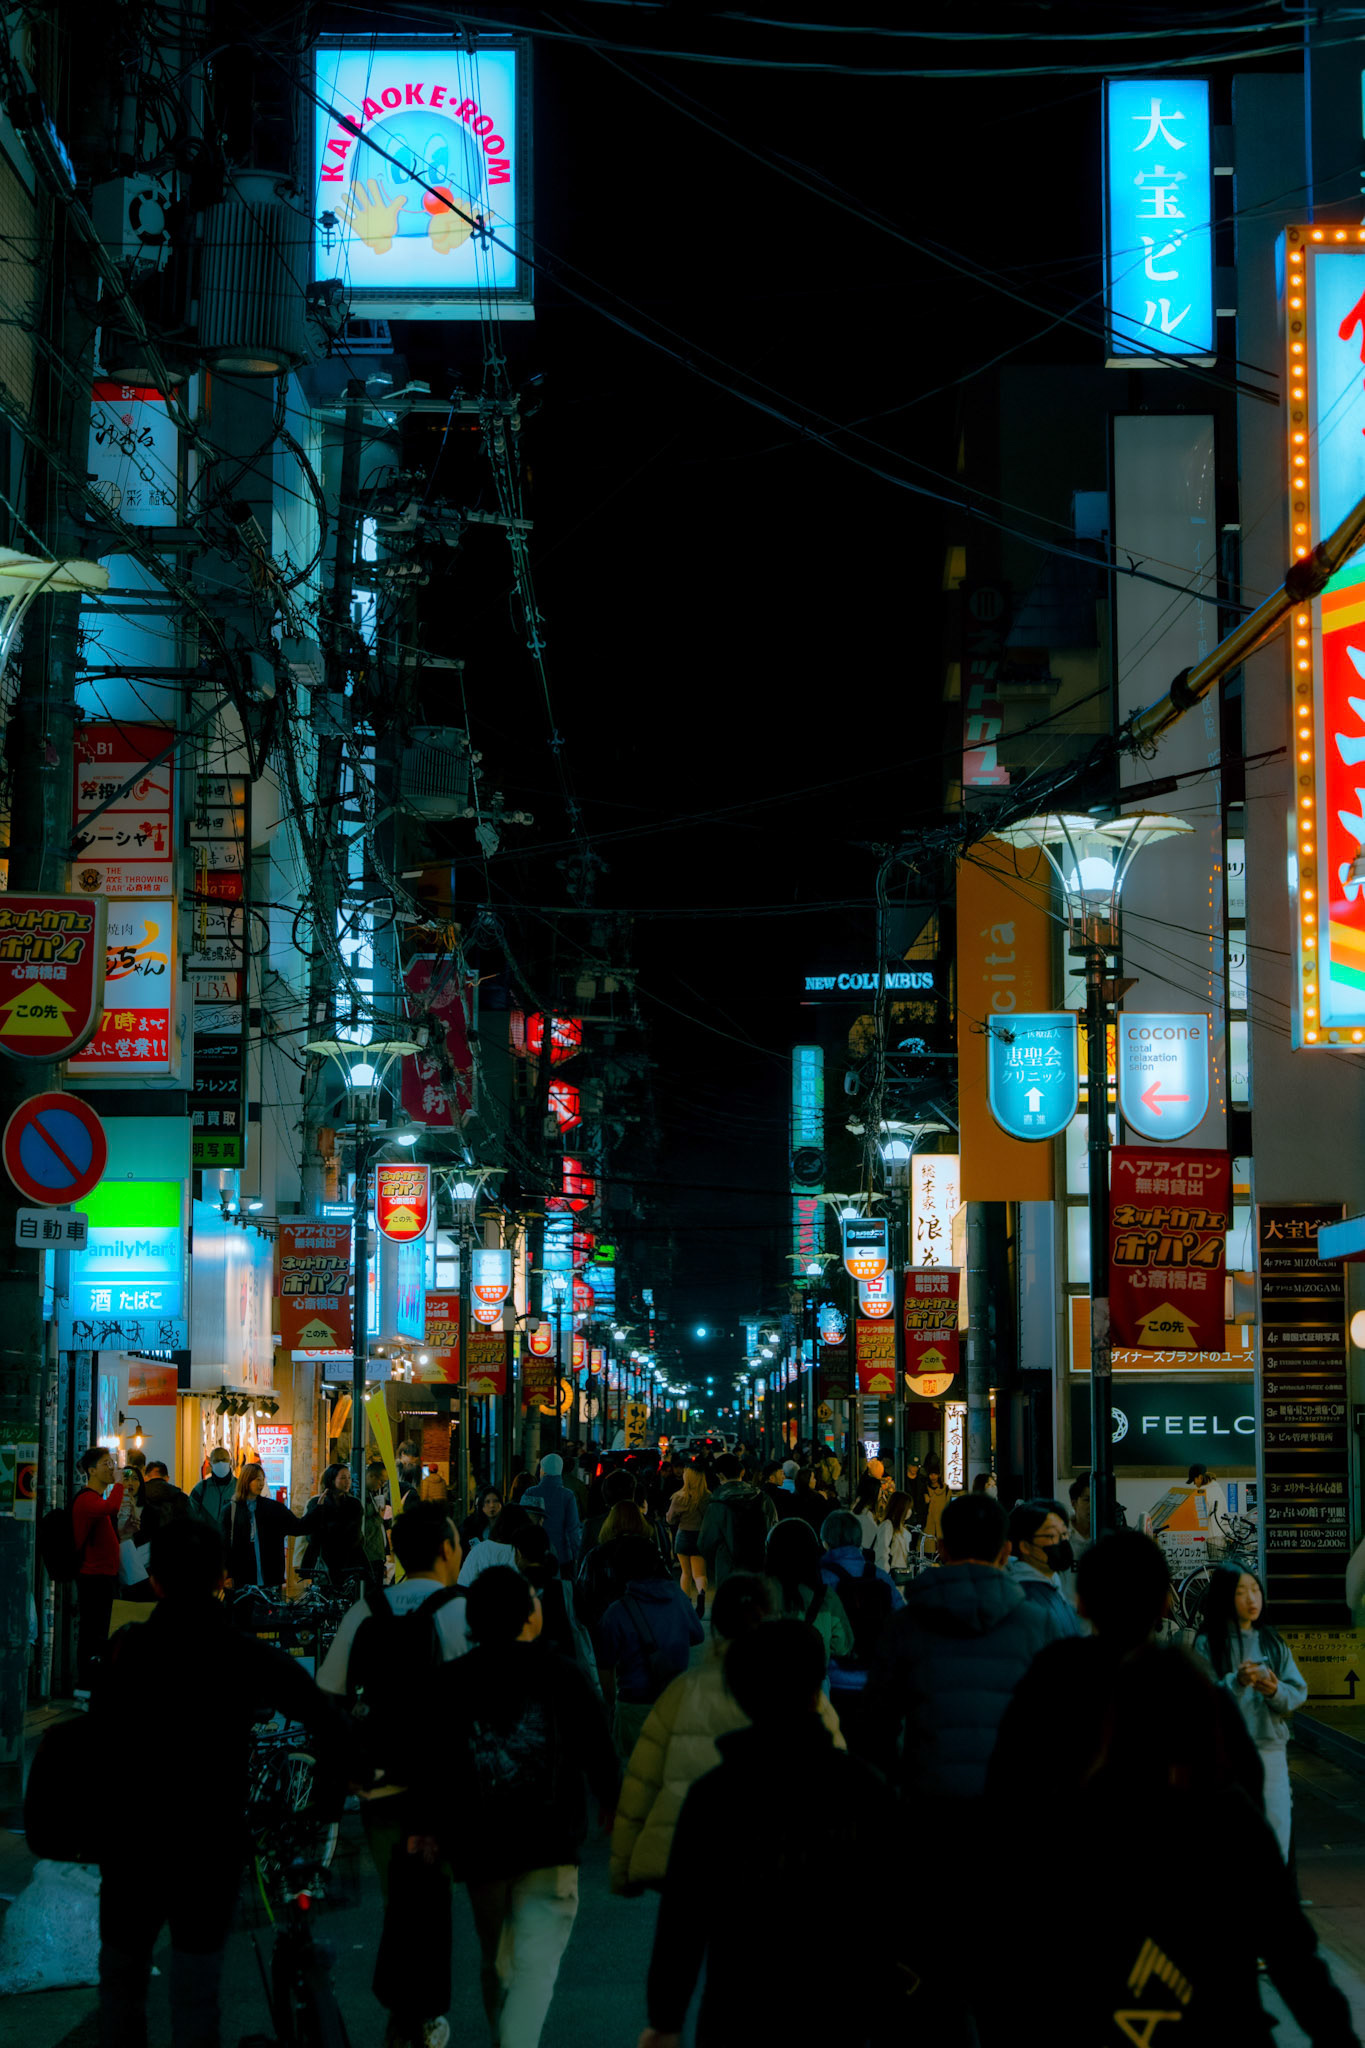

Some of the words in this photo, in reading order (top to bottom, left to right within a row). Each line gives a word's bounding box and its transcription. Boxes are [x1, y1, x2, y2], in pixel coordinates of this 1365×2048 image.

[1131, 96, 1190, 335] 大宝ビル
[96, 742, 113, 755] B1
[0, 935, 86, 964] ポパイ
[805, 976, 837, 991] NEW
[838, 972, 935, 991] COLUMBUS
[17, 1005, 58, 1018] この先
[1127, 1026, 1201, 1041] cocone
[1129, 1043, 1152, 1053] total
[1129, 1053, 1177, 1062] relaxation
[1129, 1063, 1154, 1071] salon
[1001, 1069, 1066, 1084] クリニック
[1117, 1159, 1223, 1180] ヘアアイロン
[382, 1182, 424, 1197] ポパイ
[1135, 1178, 1204, 1196] 無料貸出
[1113, 1204, 1226, 1232] ネットカフェ
[20, 1217, 85, 1242] 自動車
[283, 1226, 349, 1239] ヘアアイロン
[1264, 1219, 1334, 1240] 大宝ビ
[1112, 1231, 1225, 1270] ポパイ
[281, 1256, 349, 1272] ネットカフェ
[282, 1272, 347, 1297] ポパイ
[1128, 1269, 1208, 1291] 心斎橋店
[90, 1288, 113, 1313] 酒
[119, 1290, 163, 1311] たばこ
[905, 1311, 959, 1331] ポパイ
[1147, 1321, 1185, 1333] この先
[305, 1329, 328, 1338] この先
[1267, 1331, 1278, 1343] 4F
[1267, 1356, 1278, 1368] 3F
[1267, 1381, 1278, 1394] 3F
[1266, 1407, 1278, 1418] 3F
